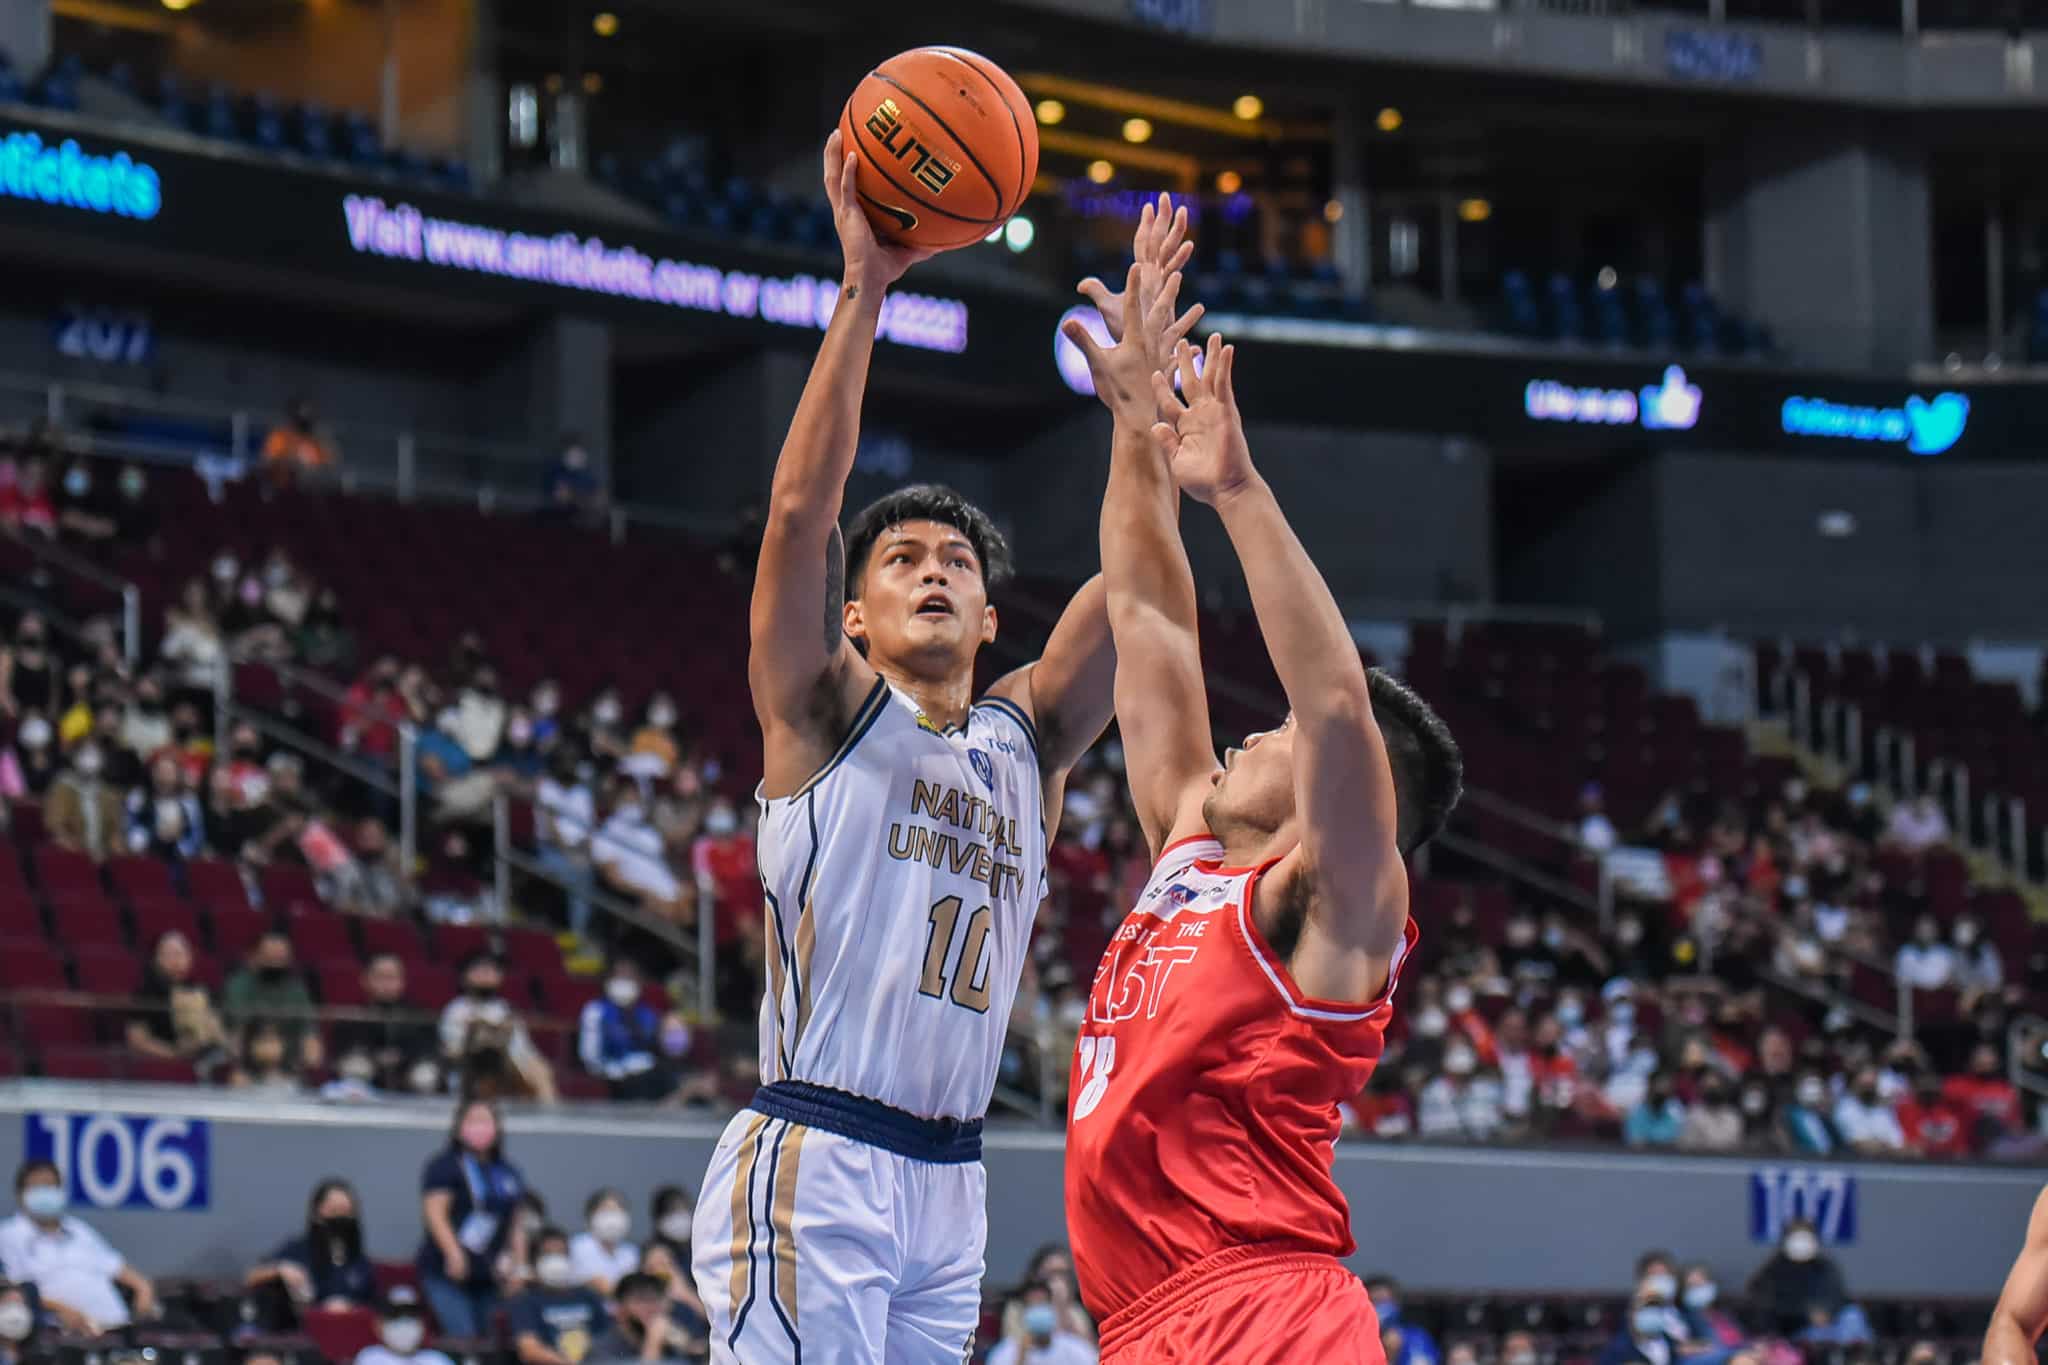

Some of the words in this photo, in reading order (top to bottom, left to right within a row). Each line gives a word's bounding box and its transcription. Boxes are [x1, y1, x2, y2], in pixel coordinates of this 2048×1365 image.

[864, 102, 957, 196] ELITE
[918, 894, 991, 1015] 10
[1176, 920, 1210, 938] THE
[39, 1111, 196, 1210] 106
[1761, 1166, 1844, 1243] 107
